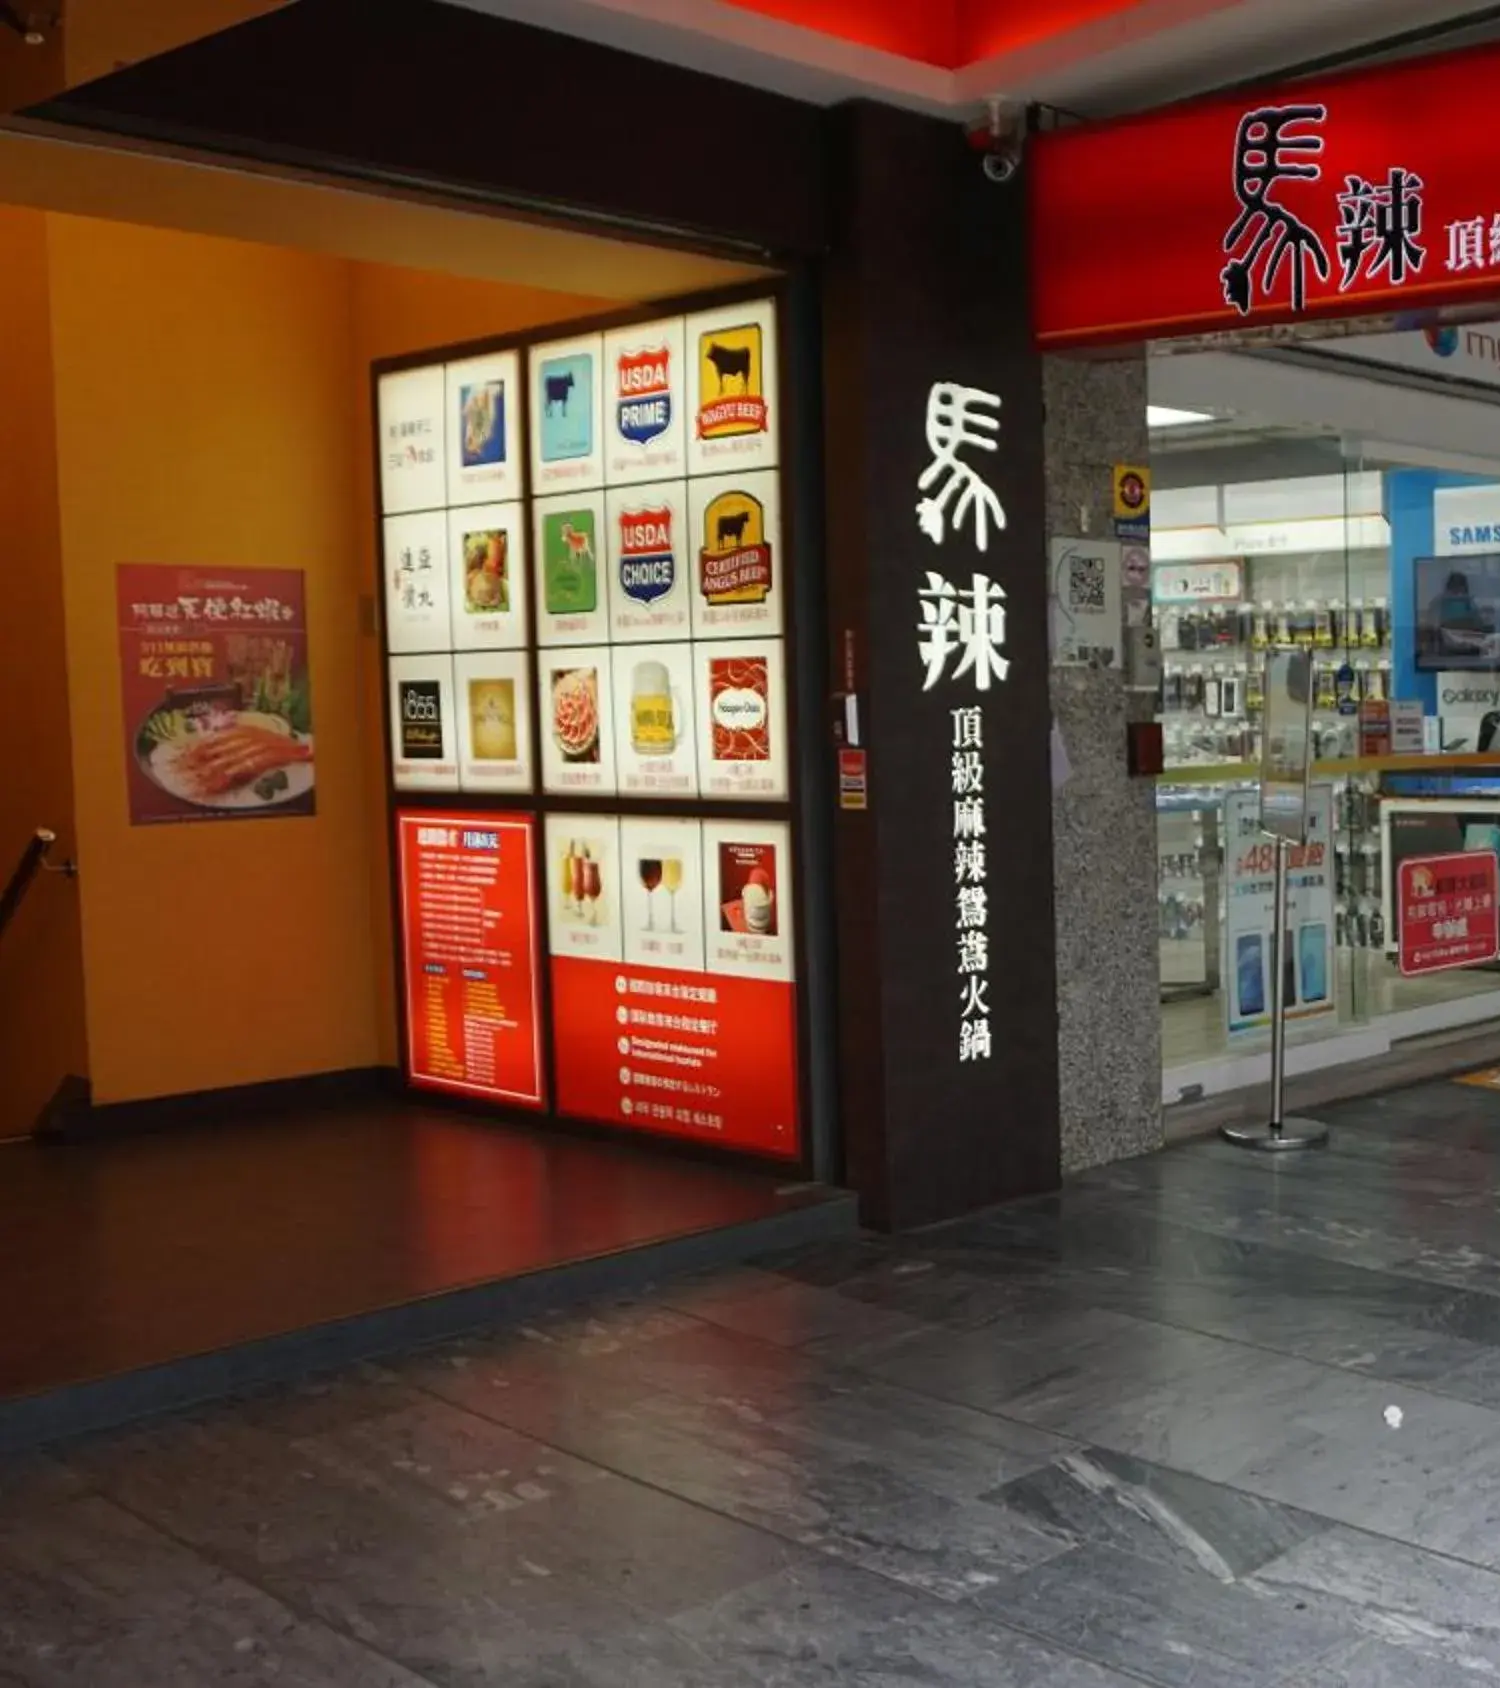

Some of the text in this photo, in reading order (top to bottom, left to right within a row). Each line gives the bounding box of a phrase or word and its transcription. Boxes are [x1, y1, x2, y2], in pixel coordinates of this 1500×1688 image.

[621, 363, 666, 390] USDA
[621, 401, 666, 429] PRIME
[737, 402, 763, 420] BEEF
[624, 523, 668, 548] USDA
[623, 561, 672, 586] CHOICE
[949, 706, 992, 1063] 頂級麻辣鴛鴦火鍋
